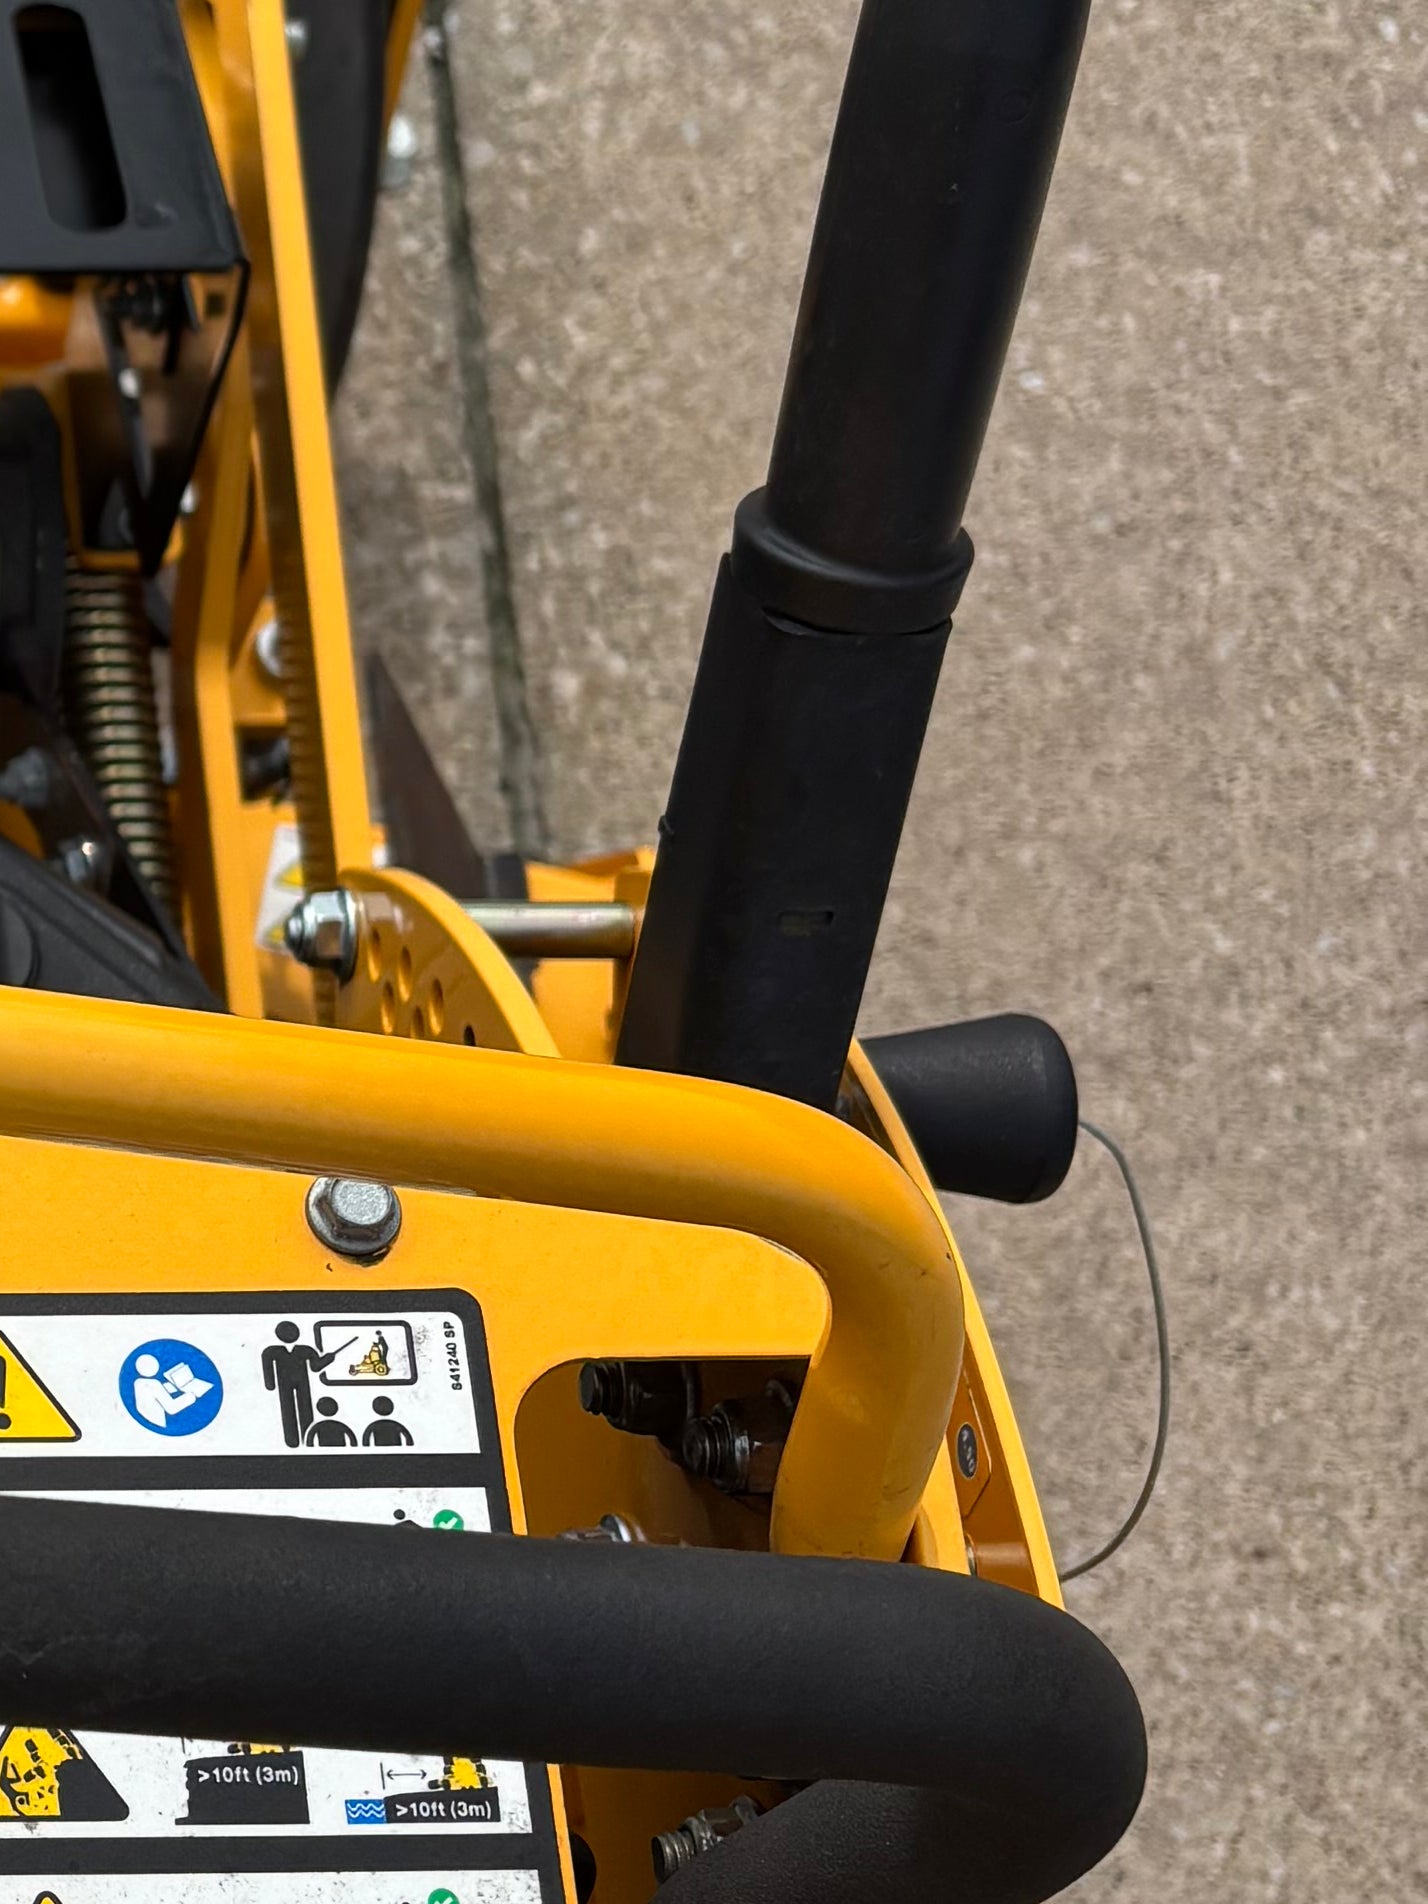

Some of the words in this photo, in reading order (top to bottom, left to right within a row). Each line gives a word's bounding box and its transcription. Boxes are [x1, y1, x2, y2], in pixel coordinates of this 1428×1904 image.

[443, 1321, 455, 1338] SP
[197, 1766, 250, 1783] >10ft
[256, 1765, 300, 1787] (3m)
[395, 1801, 446, 1818] >10ft
[450, 1800, 493, 1820] (3m)
